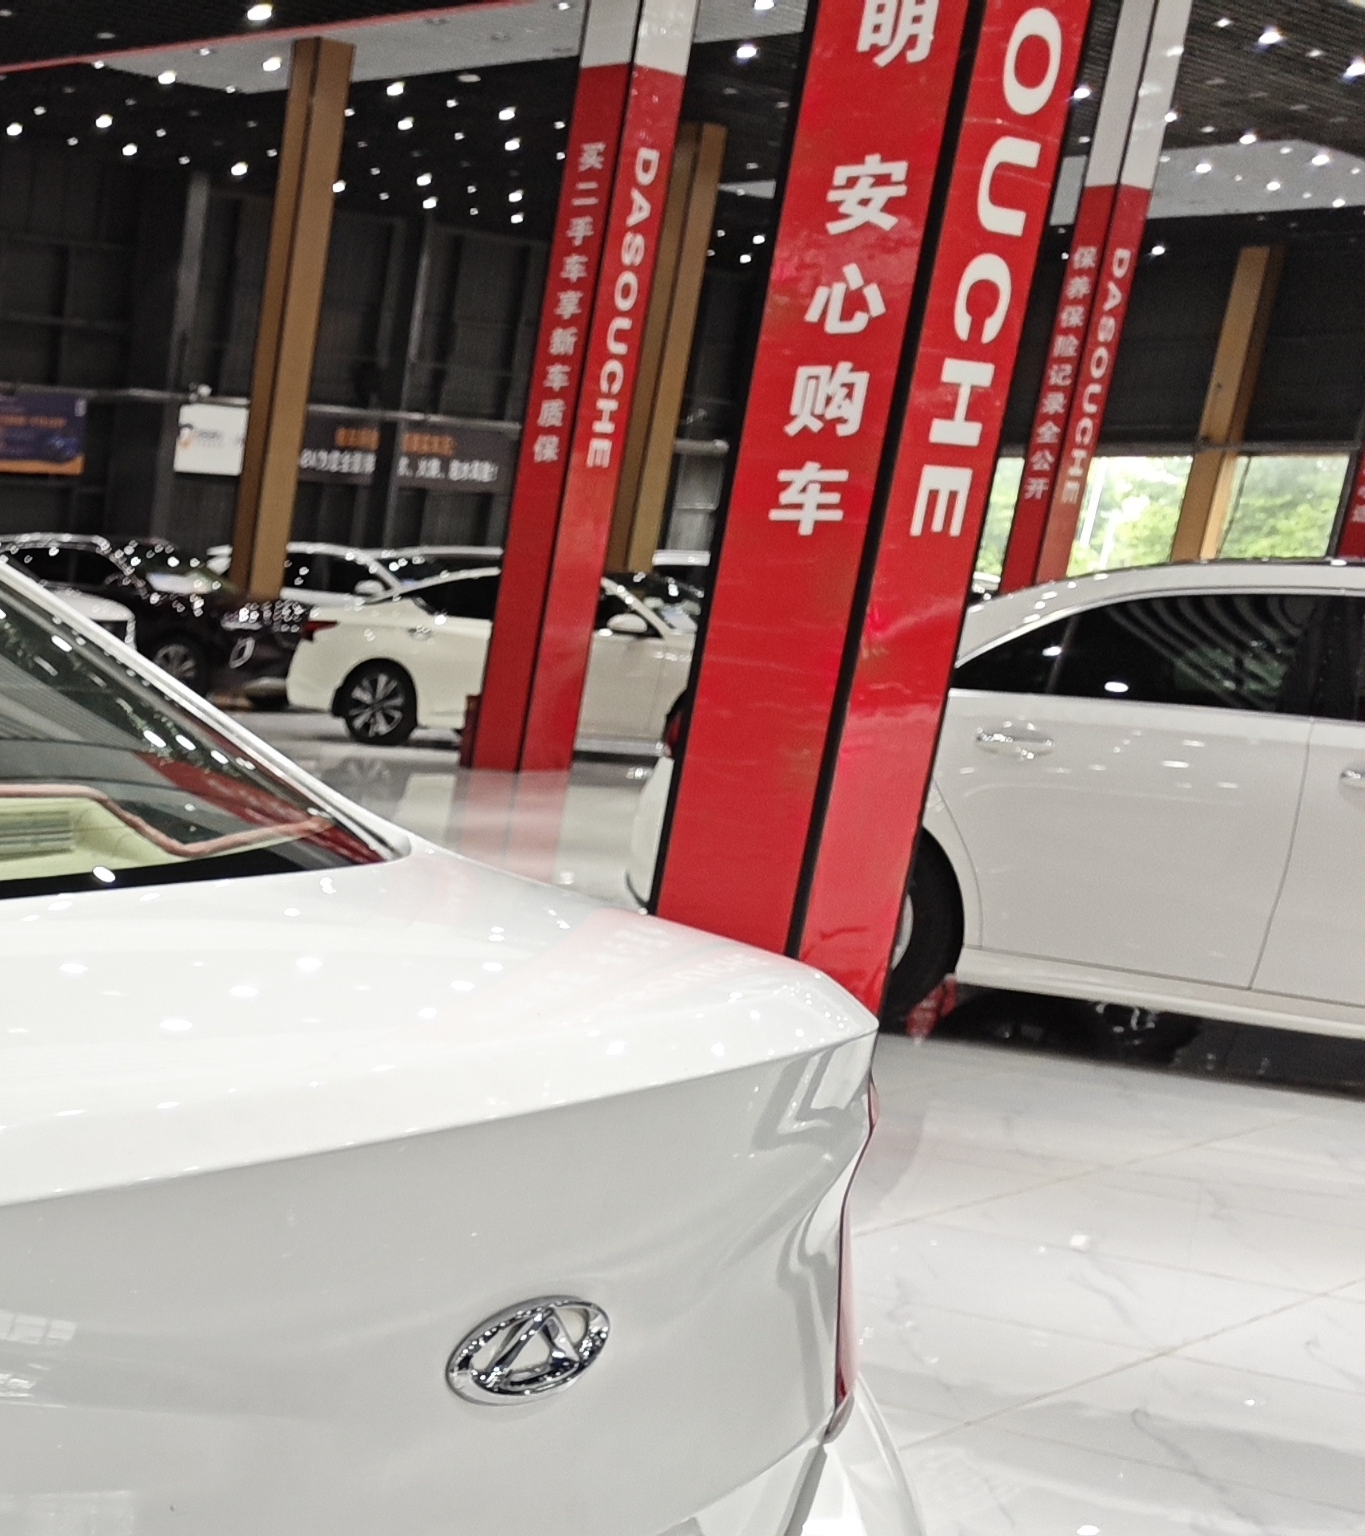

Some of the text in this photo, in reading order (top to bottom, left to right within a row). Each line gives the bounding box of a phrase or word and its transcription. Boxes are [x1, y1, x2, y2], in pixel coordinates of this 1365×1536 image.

[533, 141, 607, 464] 买二手车享新车质保
[585, 146, 661, 469] DASOUCHE
[768, 153, 909, 536] 安心购车
[909, 6, 1063, 537] OUCHE
[1024, 244, 1099, 500] 保养保险记录全公开
[1060, 247, 1132, 505] DASOUCHE
